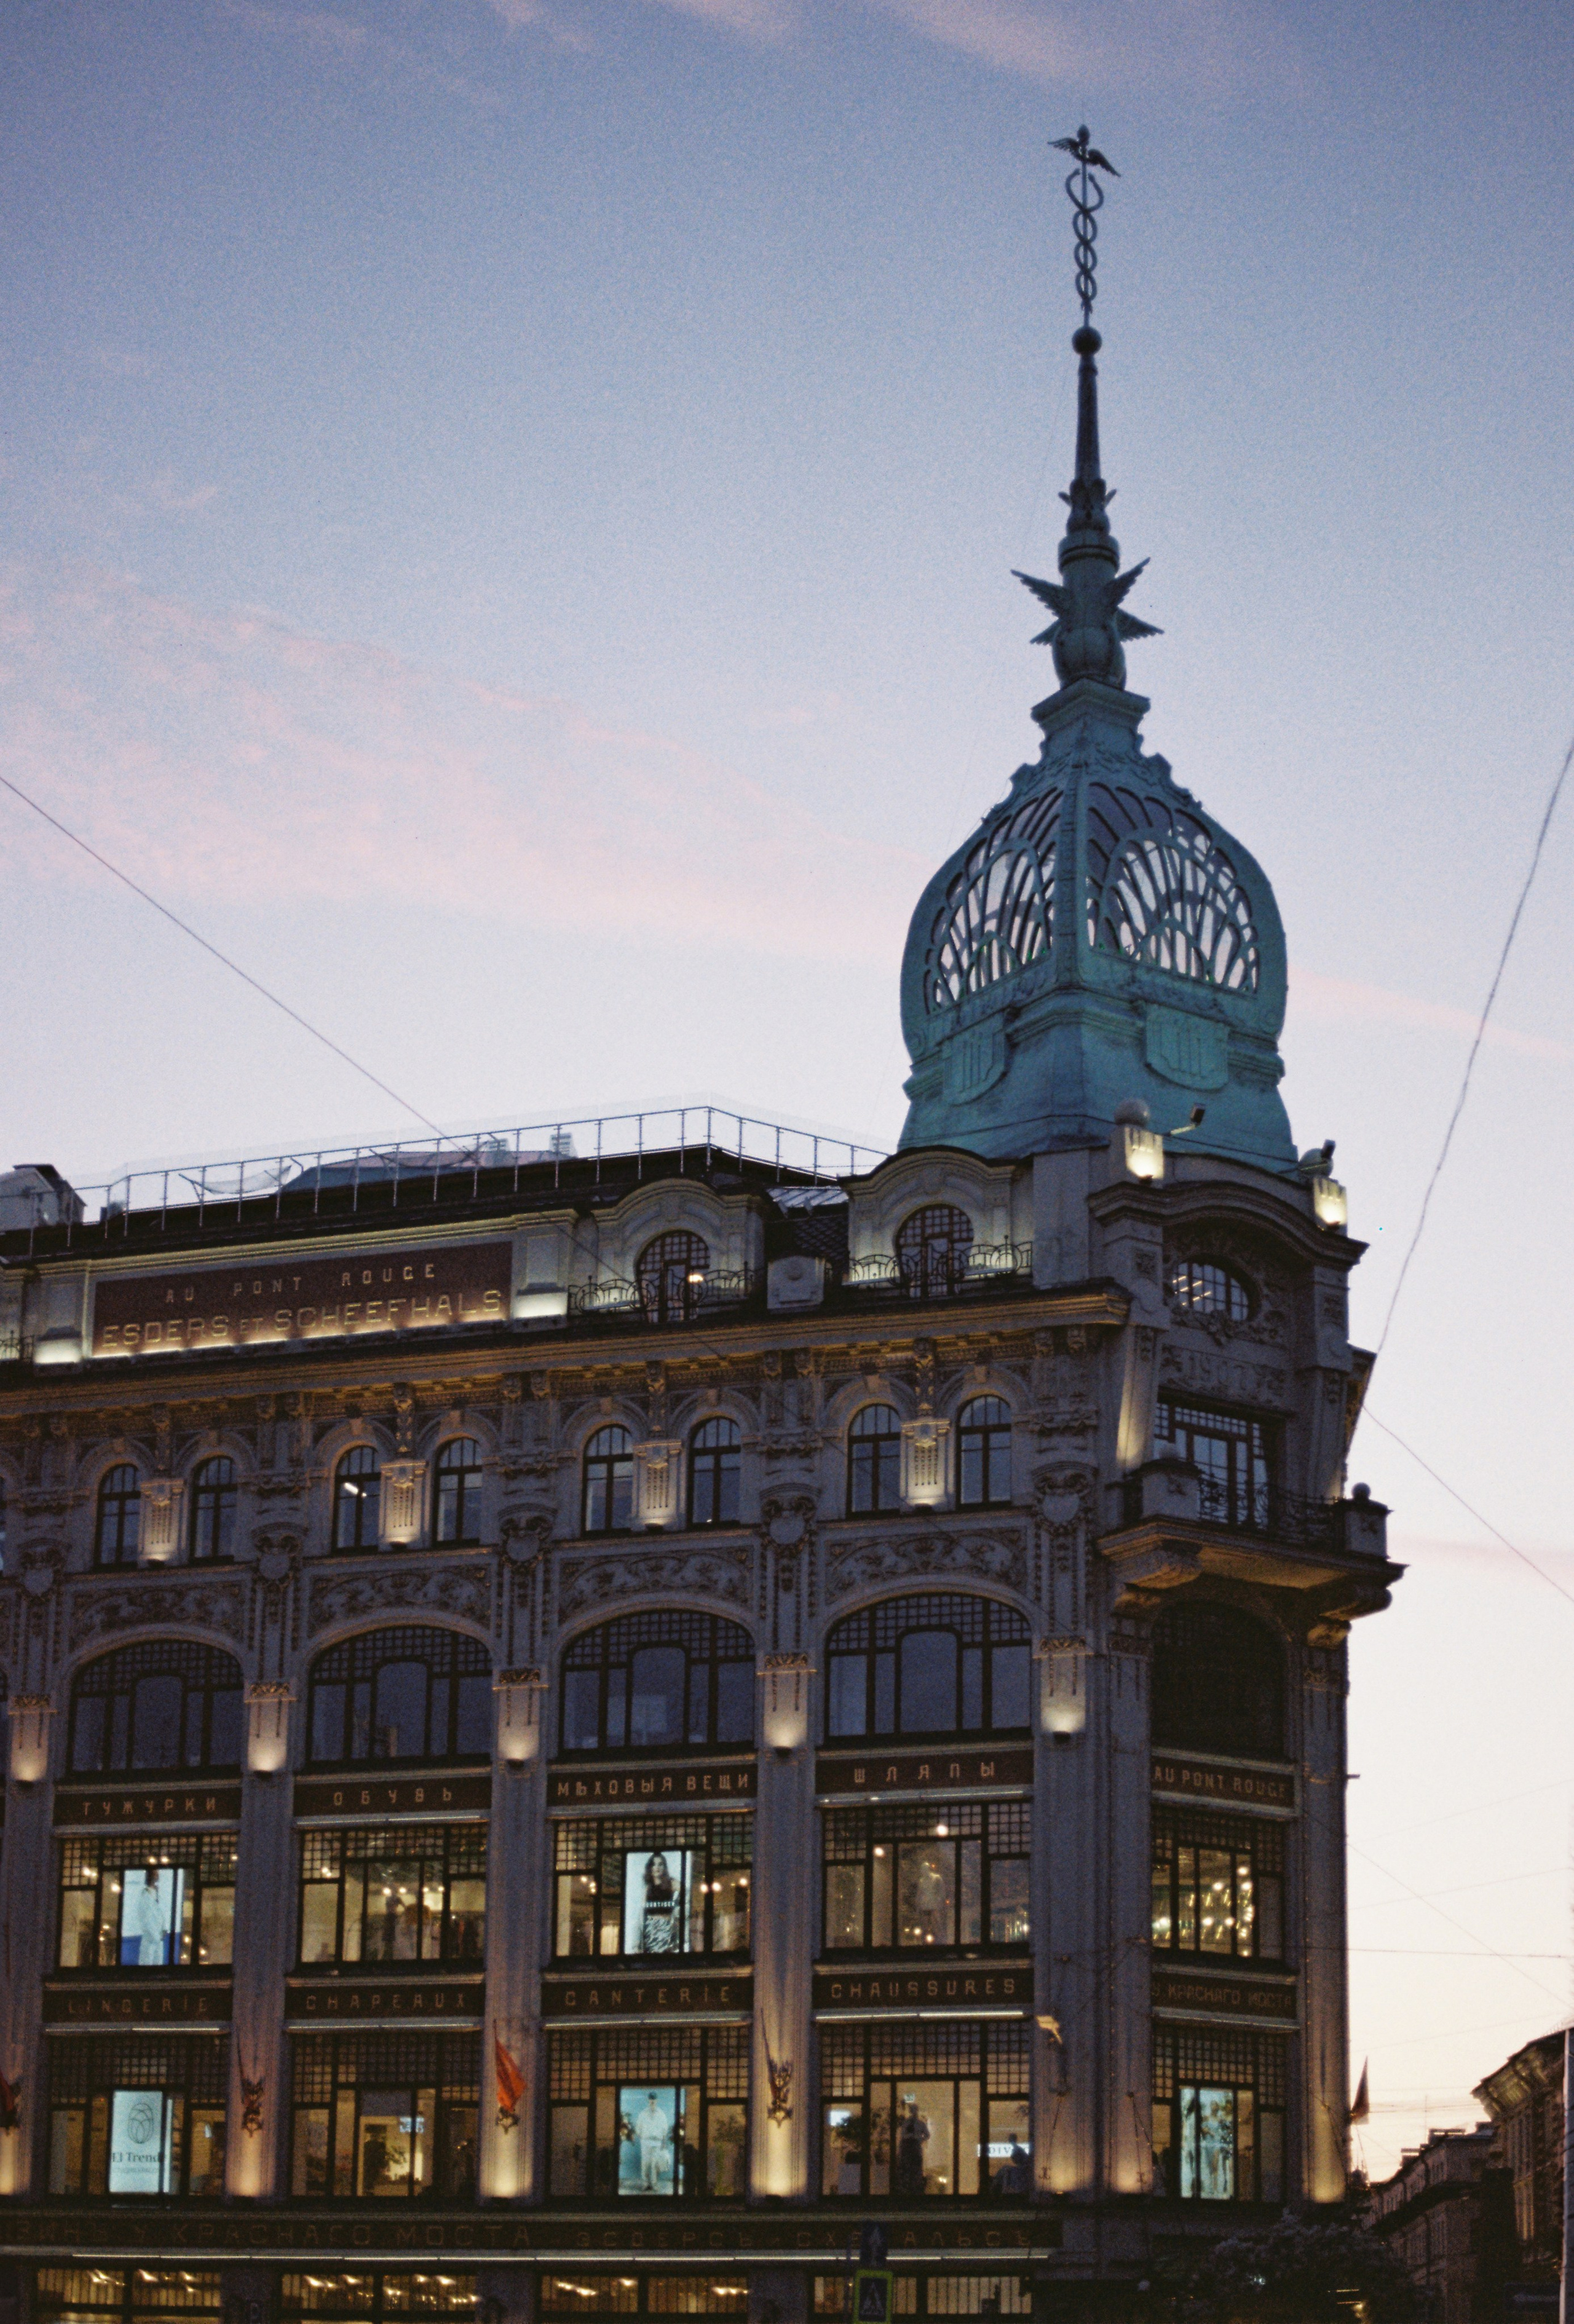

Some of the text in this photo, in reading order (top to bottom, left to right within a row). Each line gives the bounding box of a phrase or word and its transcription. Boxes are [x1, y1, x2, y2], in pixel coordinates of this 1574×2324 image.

[165, 1262, 436, 1304] AU PONT ROUGE
[102, 1314, 229, 1348] ESDERS
[274, 1288, 502, 1332] SCHEEFHALS
[686, 1773, 749, 1792] ВЕЩИ
[853, 1760, 995, 1784] ШЛЯПЫ
[1153, 1765, 1175, 1783] AU
[1180, 1768, 1224, 1790] PONT
[82, 1796, 216, 1816] ТУЖУРКИ
[333, 1786, 453, 1807] ОБУВЬ
[831, 1977, 1015, 1999] CHAUSSURES
[305, 1991, 465, 2011] CHAPEAUX
